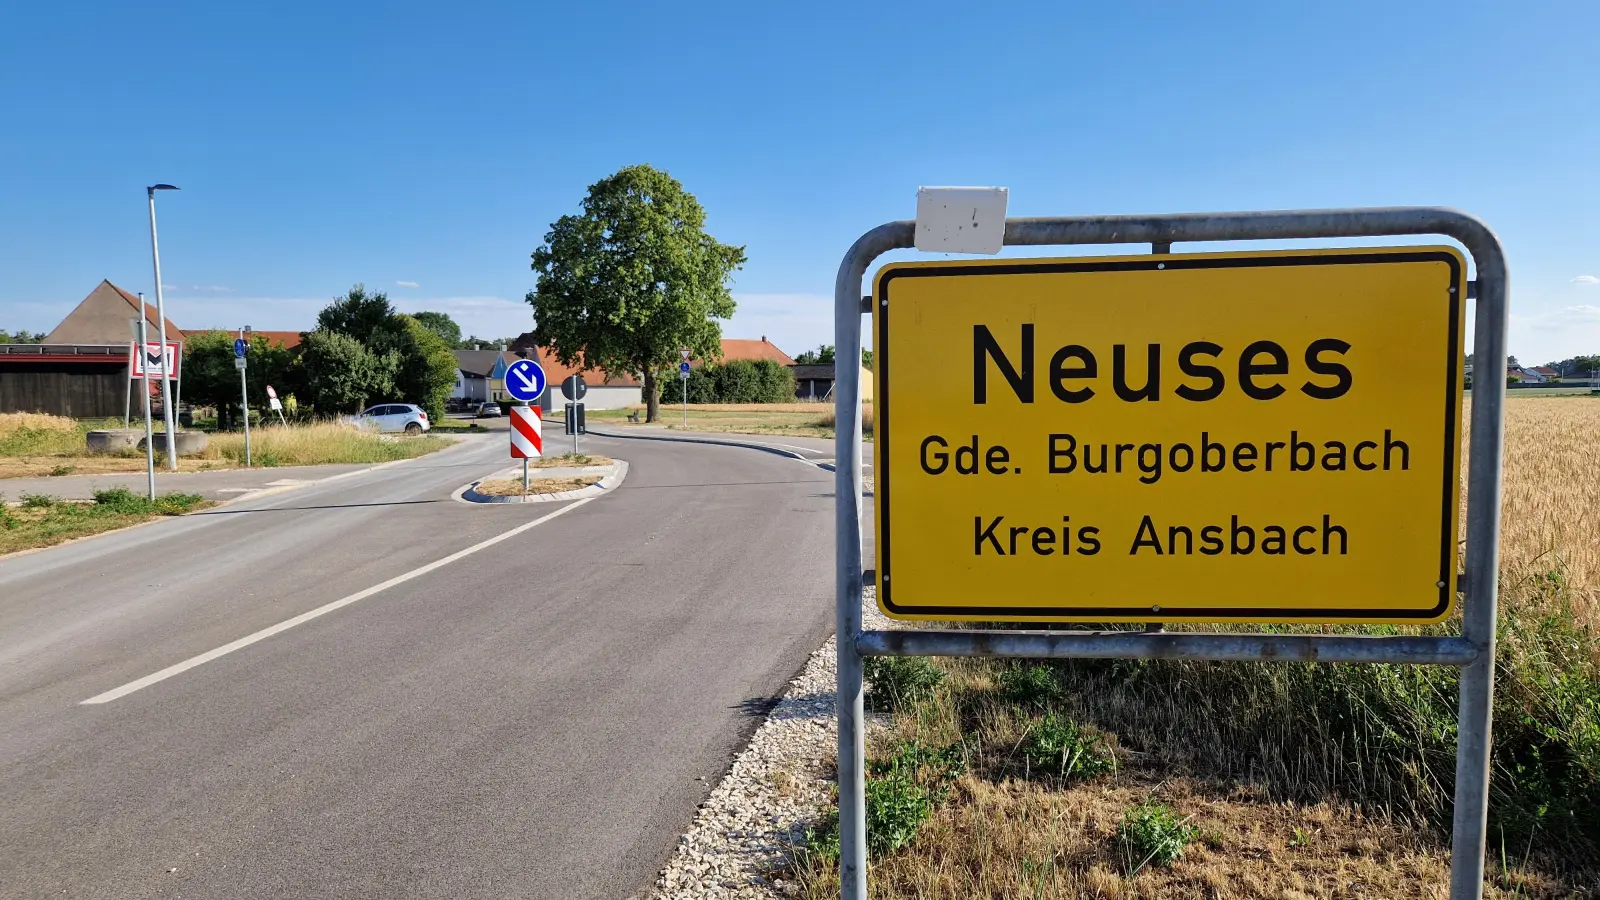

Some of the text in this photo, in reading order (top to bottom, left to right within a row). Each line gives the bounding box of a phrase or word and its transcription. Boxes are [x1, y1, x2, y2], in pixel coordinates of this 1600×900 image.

[973, 323, 1353, 405] Neuses
[919, 429, 1410, 485] Gde. Burgoberbach
[974, 514, 1348, 556] Kreis Ansbach
